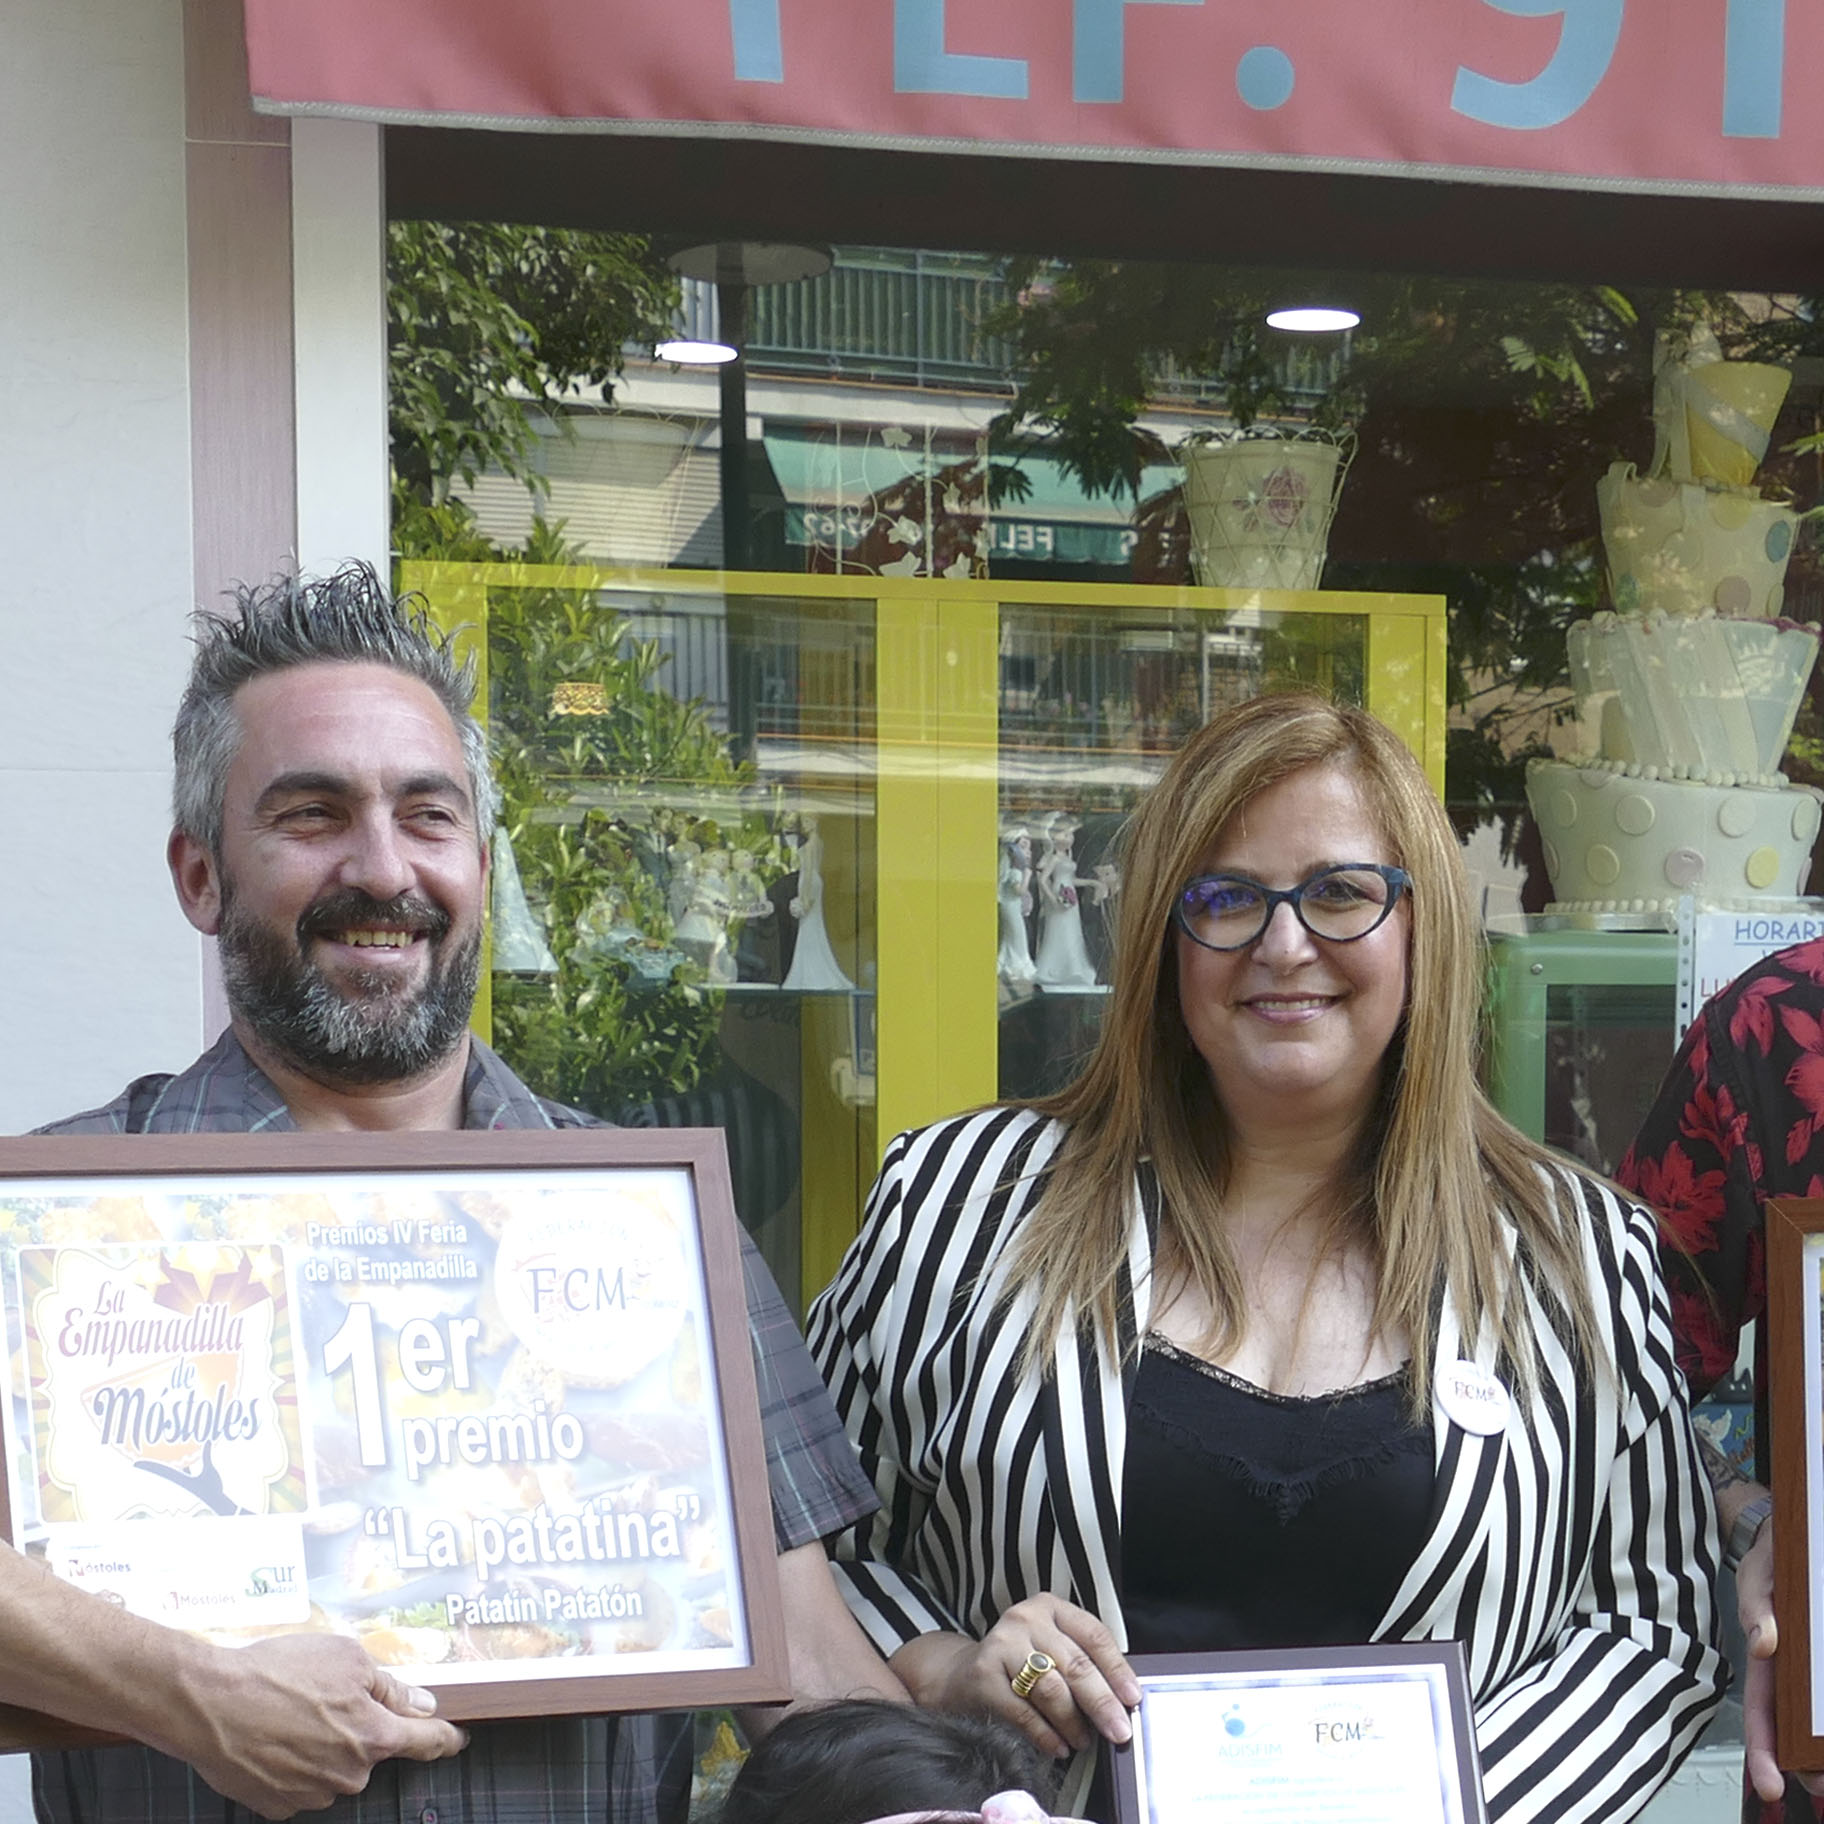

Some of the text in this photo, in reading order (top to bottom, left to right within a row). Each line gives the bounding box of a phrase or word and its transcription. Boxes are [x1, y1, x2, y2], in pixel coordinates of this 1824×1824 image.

[307, 1219, 467, 1246] Premios IV Feria
[304, 1255, 478, 1286] de la Empanadilla
[527, 1266, 627, 1314] FCM
[94, 1280, 125, 1316] La
[58, 1304, 244, 1368] Empanadilla
[171, 1357, 195, 1390] de
[323, 1303, 481, 1467] 1er
[94, 1383, 261, 1451] Móstoles
[402, 1400, 585, 1481] premio
[445, 1584, 643, 1626] Patatín Patatón
[1315, 1721, 1362, 1744] FCM
